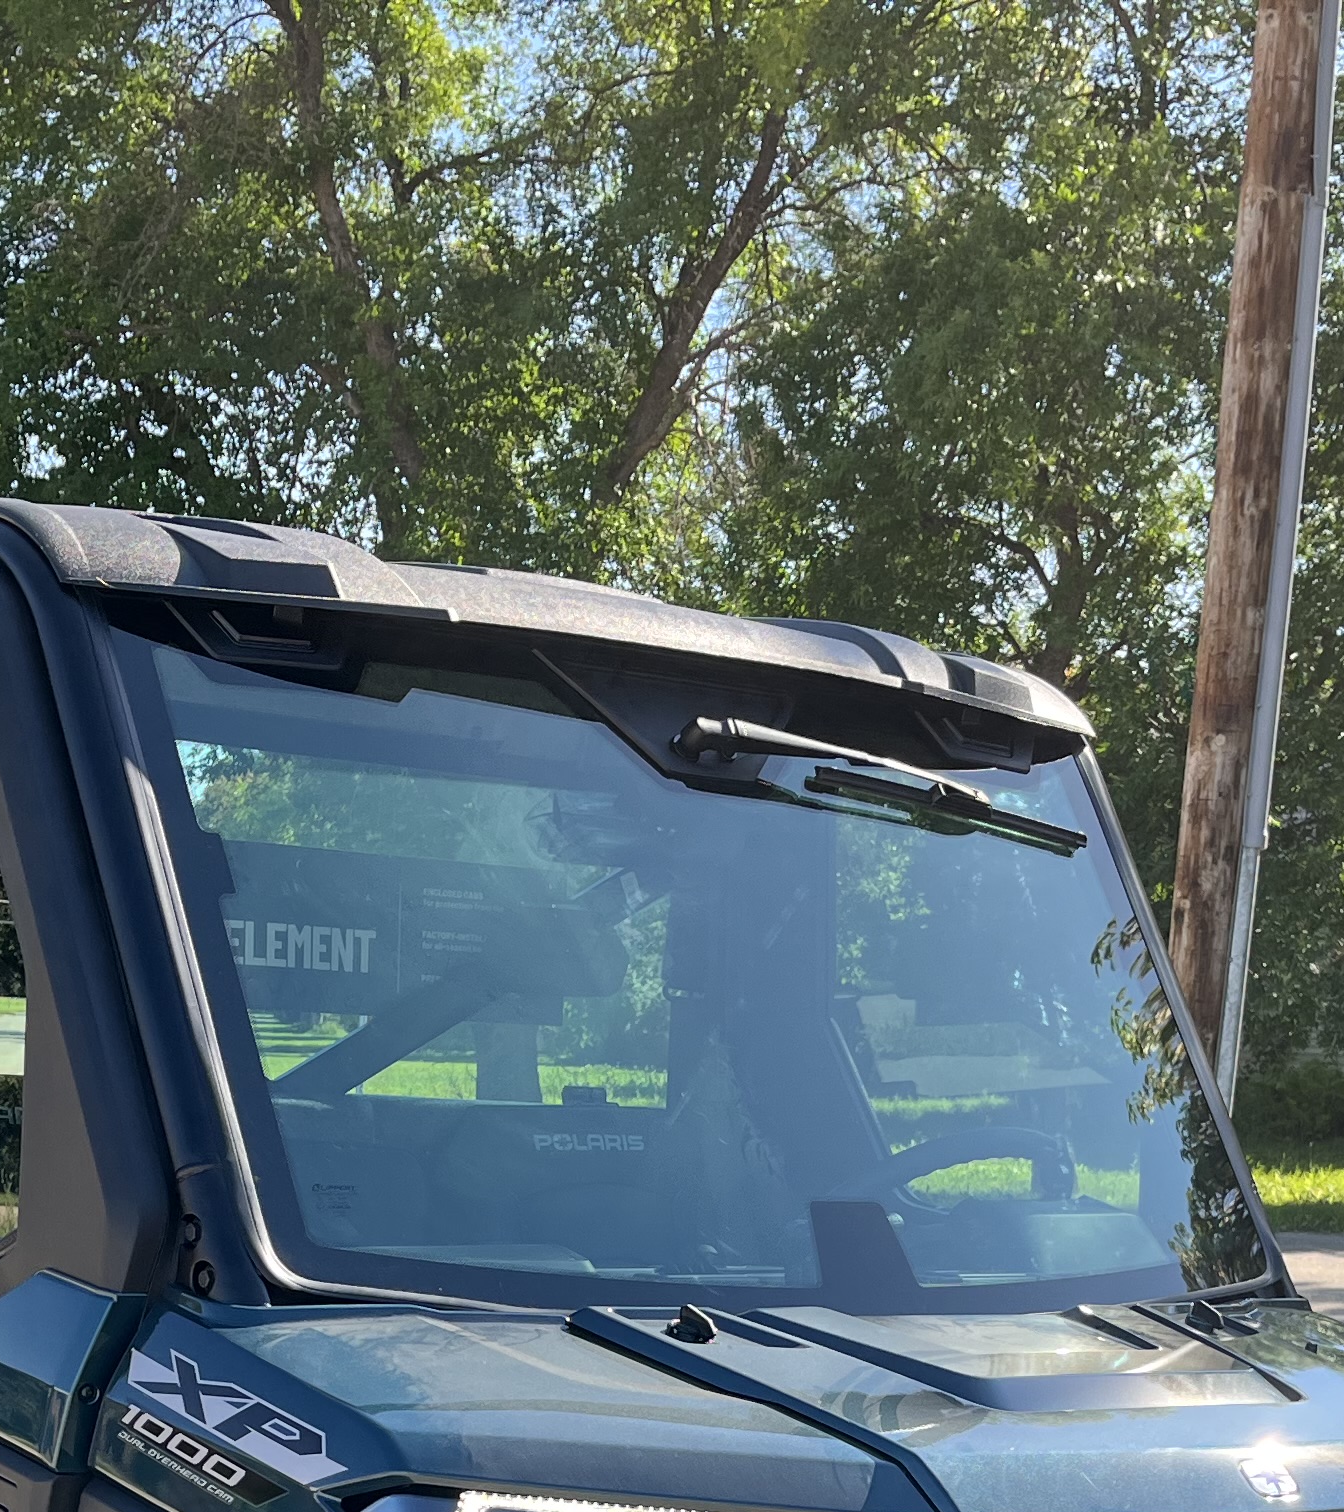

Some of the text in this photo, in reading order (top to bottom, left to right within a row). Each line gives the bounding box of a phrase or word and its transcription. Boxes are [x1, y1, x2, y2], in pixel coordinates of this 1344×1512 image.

[533, 1133, 645, 1152] POLARIS
[129, 1349, 327, 1457] XP
[117, 1430, 234, 1504] DUAL OVERHEAD CAM
[120, 1403, 246, 1487] 1000
